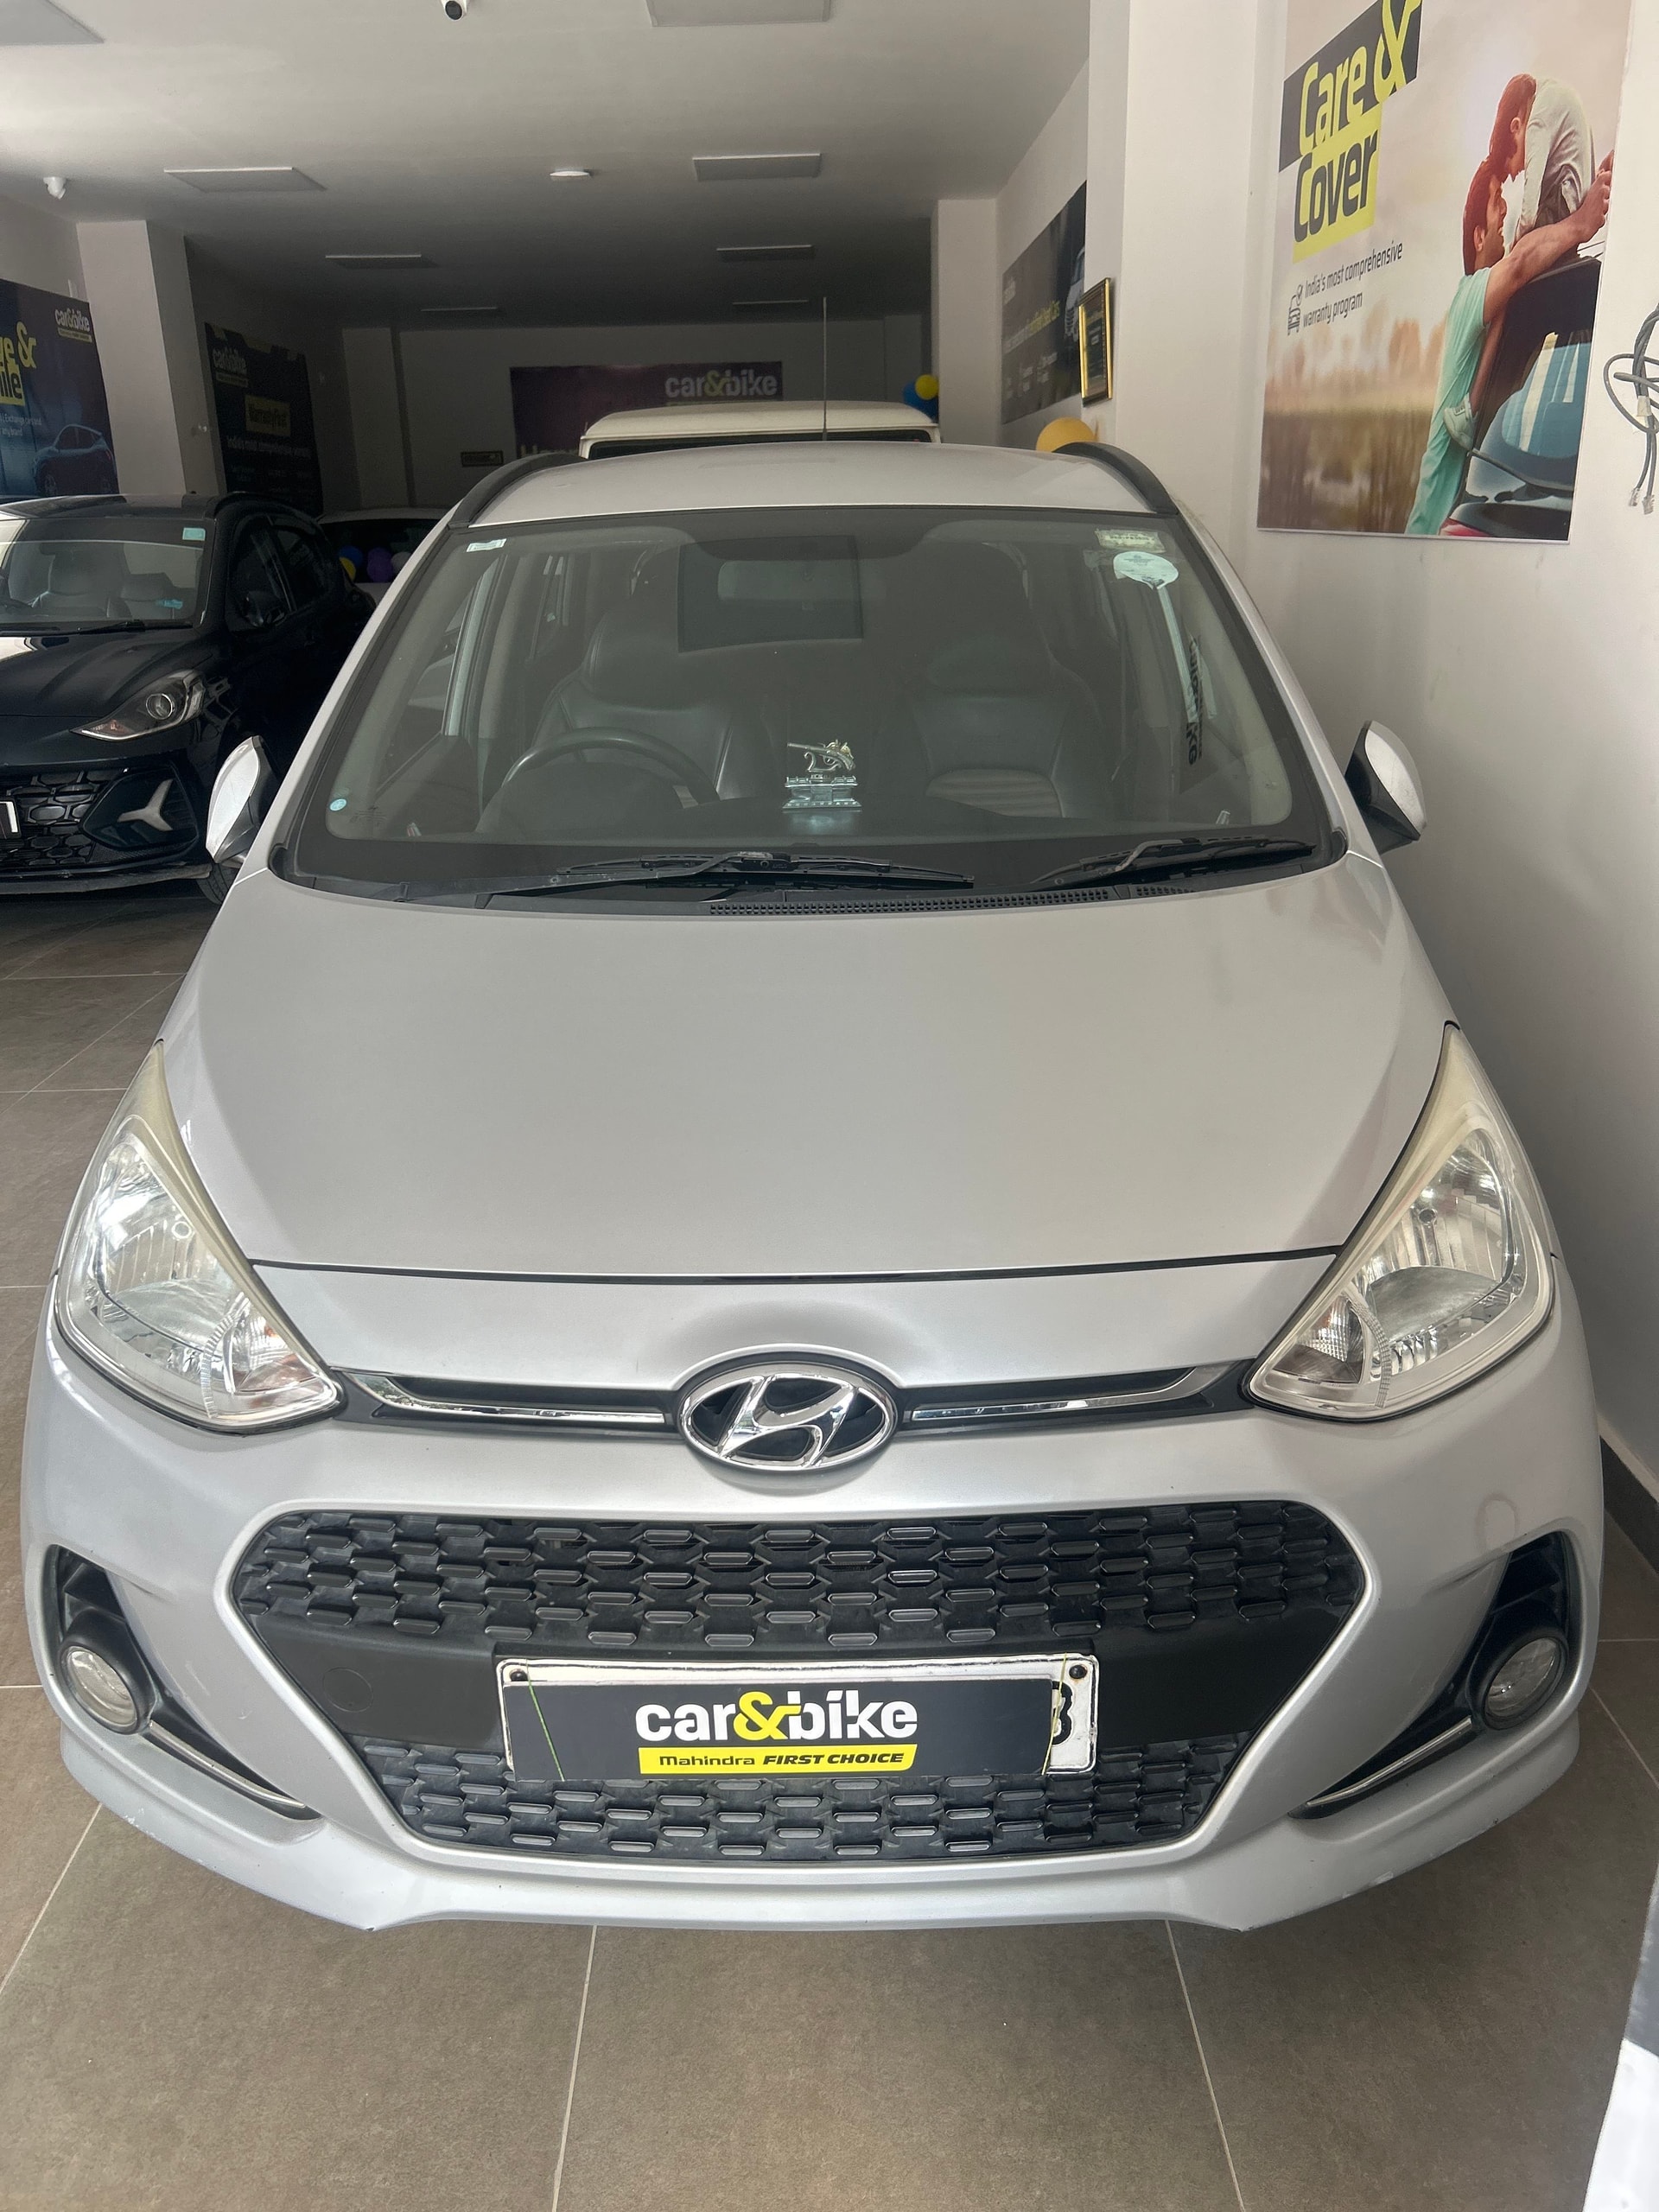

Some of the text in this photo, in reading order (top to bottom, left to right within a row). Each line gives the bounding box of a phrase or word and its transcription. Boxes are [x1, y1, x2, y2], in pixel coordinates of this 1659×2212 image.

[1299, 0, 1424, 156] Care &
[1294, 130, 1378, 243] Cover
[1305, 240, 1403, 298] India's most comprehensive
[1303, 292, 1363, 327] warranty program
[664, 369, 778, 397] car&bike
[635, 1690, 918, 1741] car&bike
[659, 1752, 905, 1765] Mahindra FIRST CHOICE
